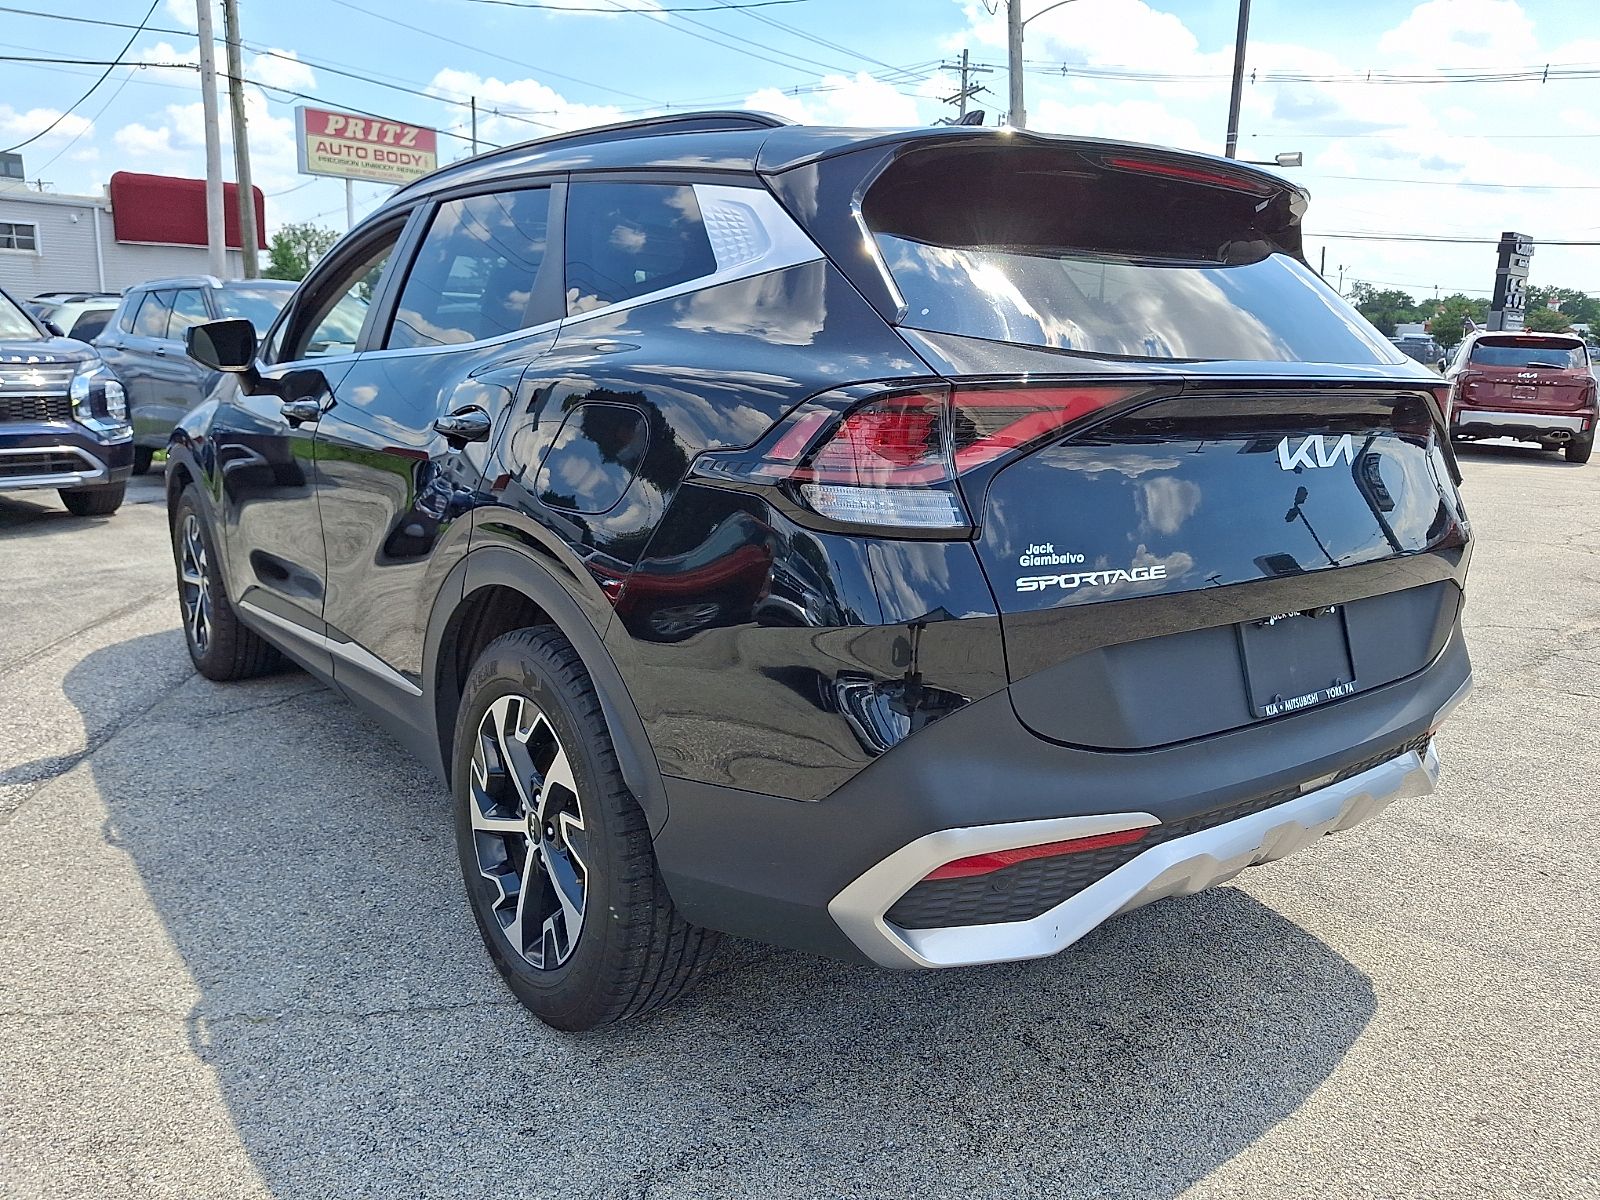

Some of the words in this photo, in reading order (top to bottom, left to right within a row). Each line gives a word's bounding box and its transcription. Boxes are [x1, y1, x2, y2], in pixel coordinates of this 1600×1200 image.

[324, 115, 420, 147] PRITZ
[316, 141, 368, 159] AUTO
[374, 149, 422, 166] BODY
[1277, 434, 1354, 470] KIA
[1019, 552, 1085, 567] Giambalvo
[1025, 543, 1054, 555] Jack
[1015, 564, 1168, 592] SPORTAGE
[1265, 704, 1279, 716] KIA
[1284, 692, 1319, 711] MITSUBISHI
